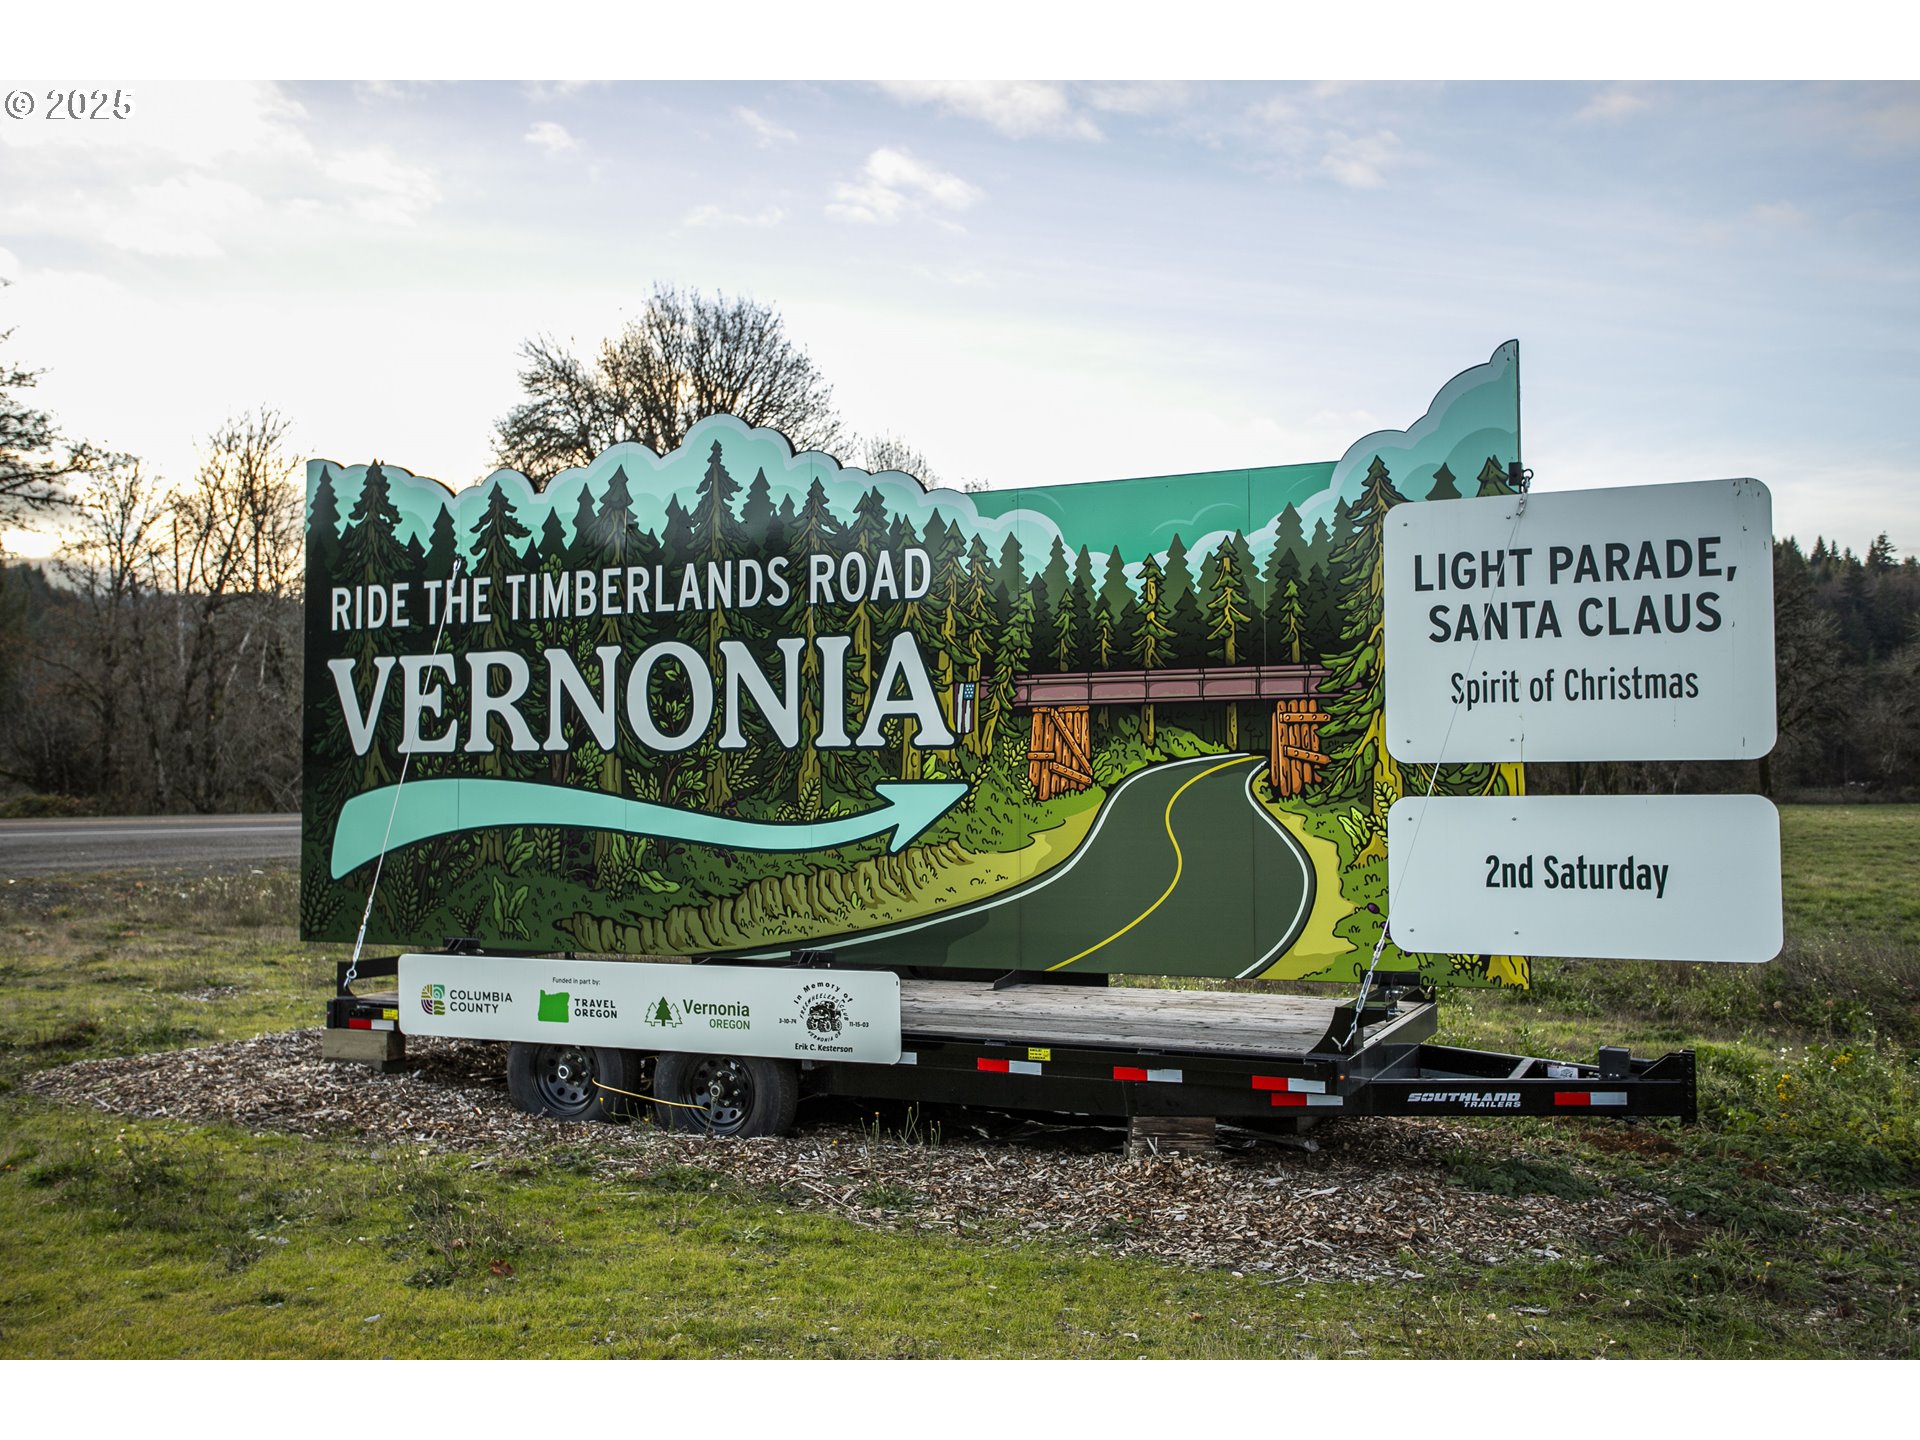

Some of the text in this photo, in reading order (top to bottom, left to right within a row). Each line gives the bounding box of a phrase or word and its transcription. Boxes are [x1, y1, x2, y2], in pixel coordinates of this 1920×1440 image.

[1413, 536, 1737, 592] LIGHT PARADE,
[331, 548, 931, 631] RIDE THE TIMBERLANDS ROAD
[1428, 591, 1722, 643] SANTA CLAUS
[327, 632, 956, 756] VERNONIA
[1450, 665, 1699, 711] Spirit of Christmas
[1485, 854, 1669, 899] 2nd Saturday
[552, 976, 572, 984] Funded
[449, 989, 513, 1003] COLUMBIA
[793, 981, 854, 1005] In Memory of
[449, 1001, 499, 1014] COUNTY
[574, 998, 616, 1009] TRAVEL
[682, 998, 750, 1017] Vernonia
[574, 1008, 618, 1019] OREGON
[709, 1018, 751, 1030] OREGON
[794, 1042, 854, 1053] Erik C. Kesterson
[1407, 1092, 1522, 1102] SOUTHLAND
